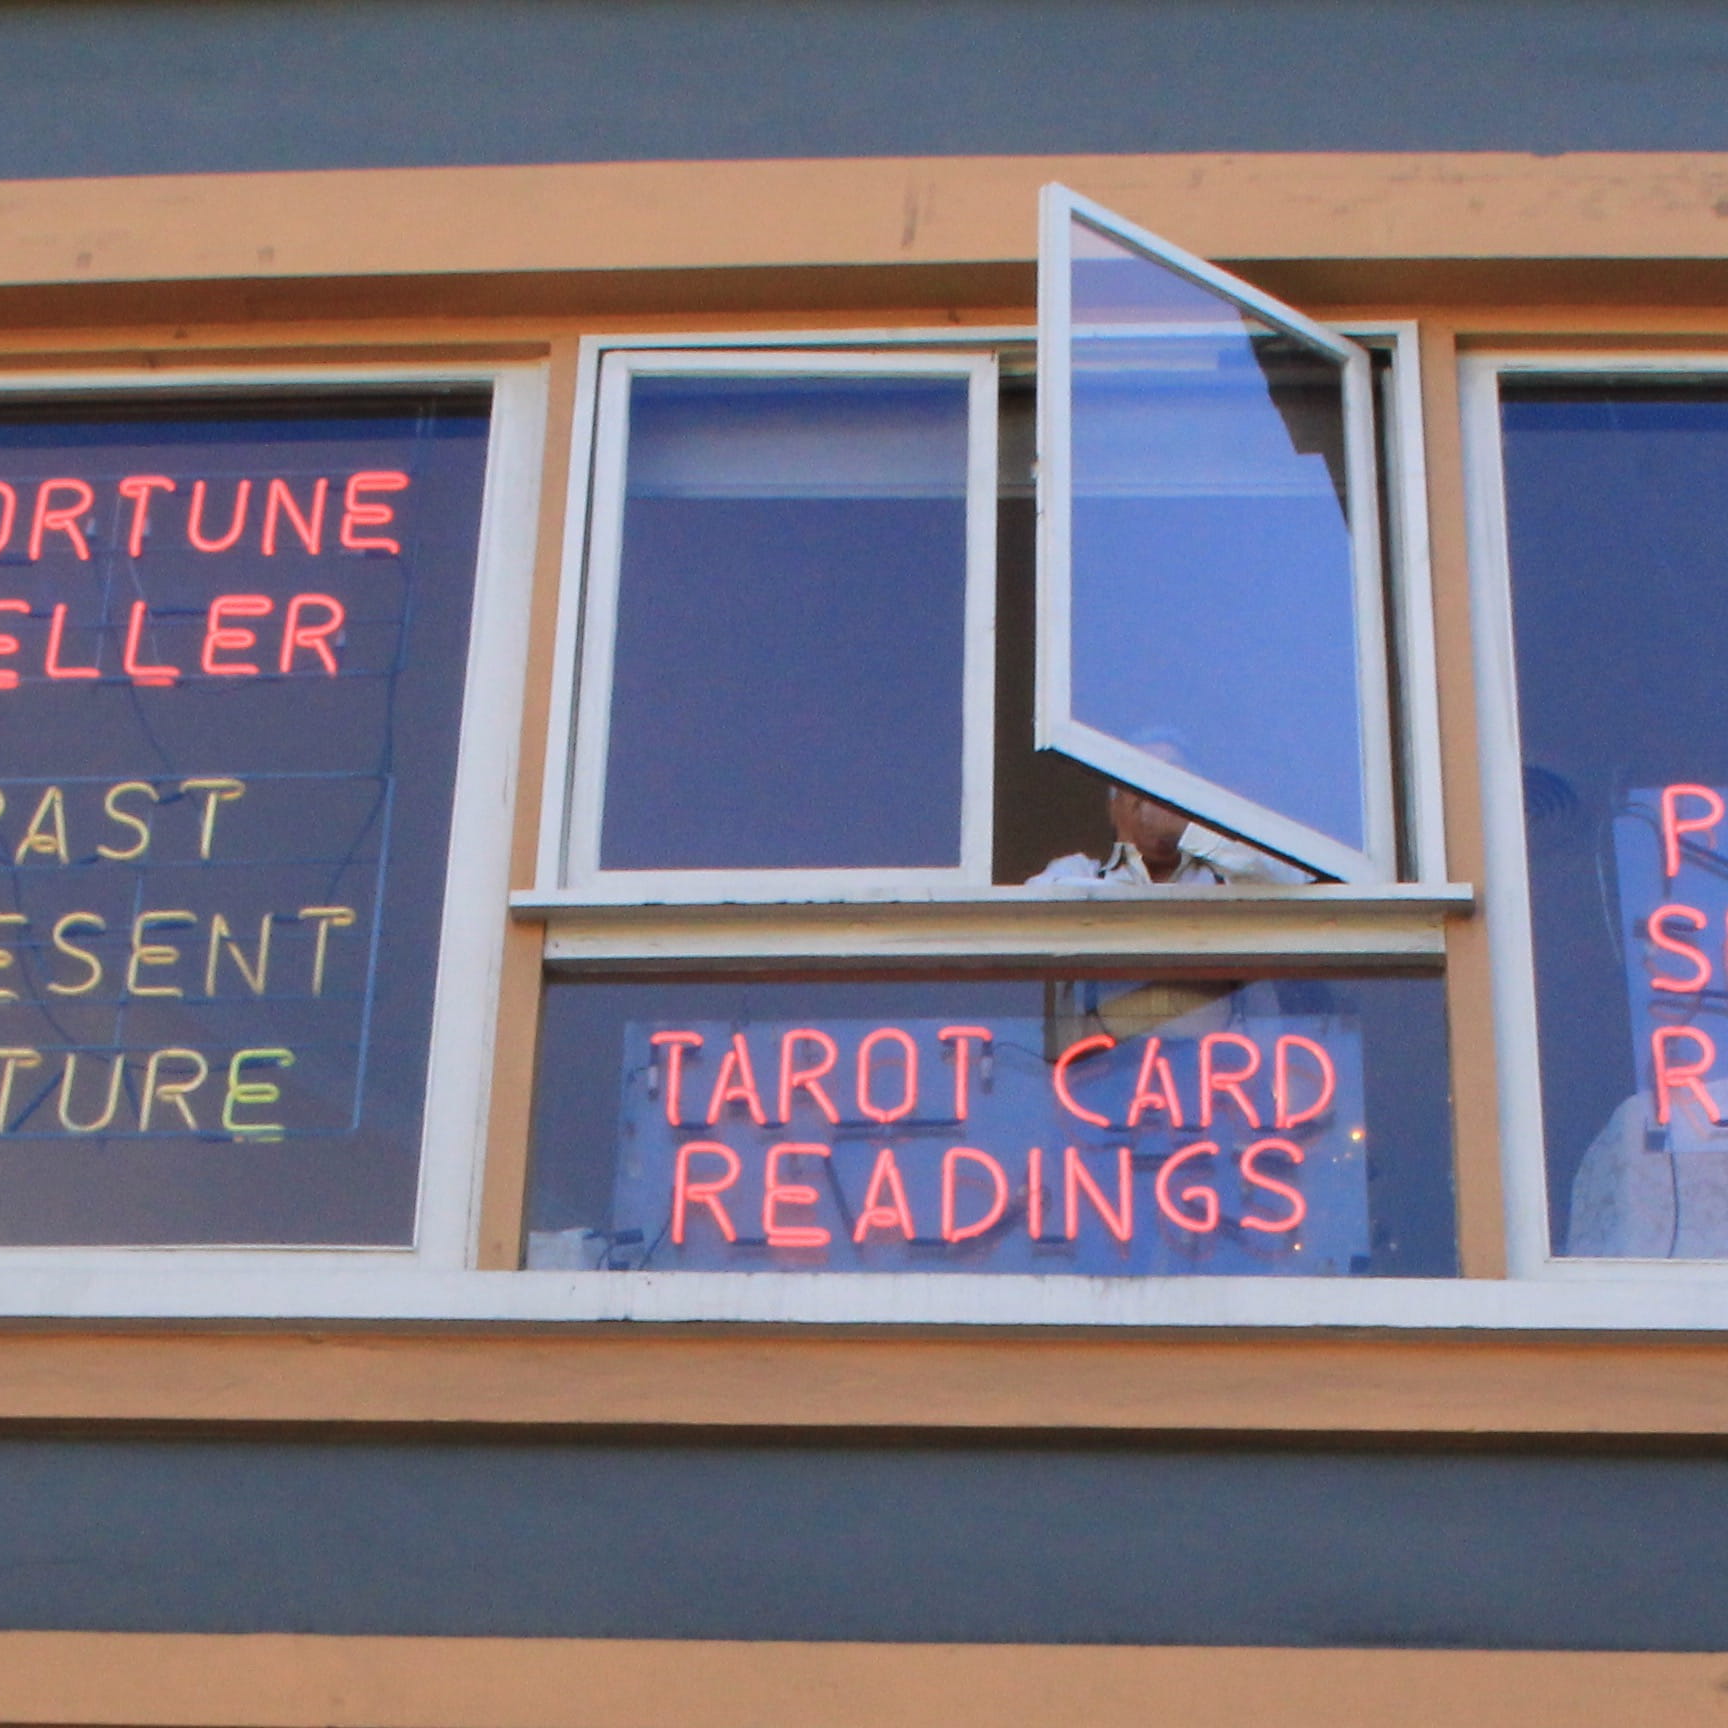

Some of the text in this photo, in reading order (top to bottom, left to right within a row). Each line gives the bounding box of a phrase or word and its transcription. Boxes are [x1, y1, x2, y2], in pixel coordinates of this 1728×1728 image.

[651, 1027, 1336, 1130] TAROT CARD
[672, 1138, 1308, 1248] READINGS
